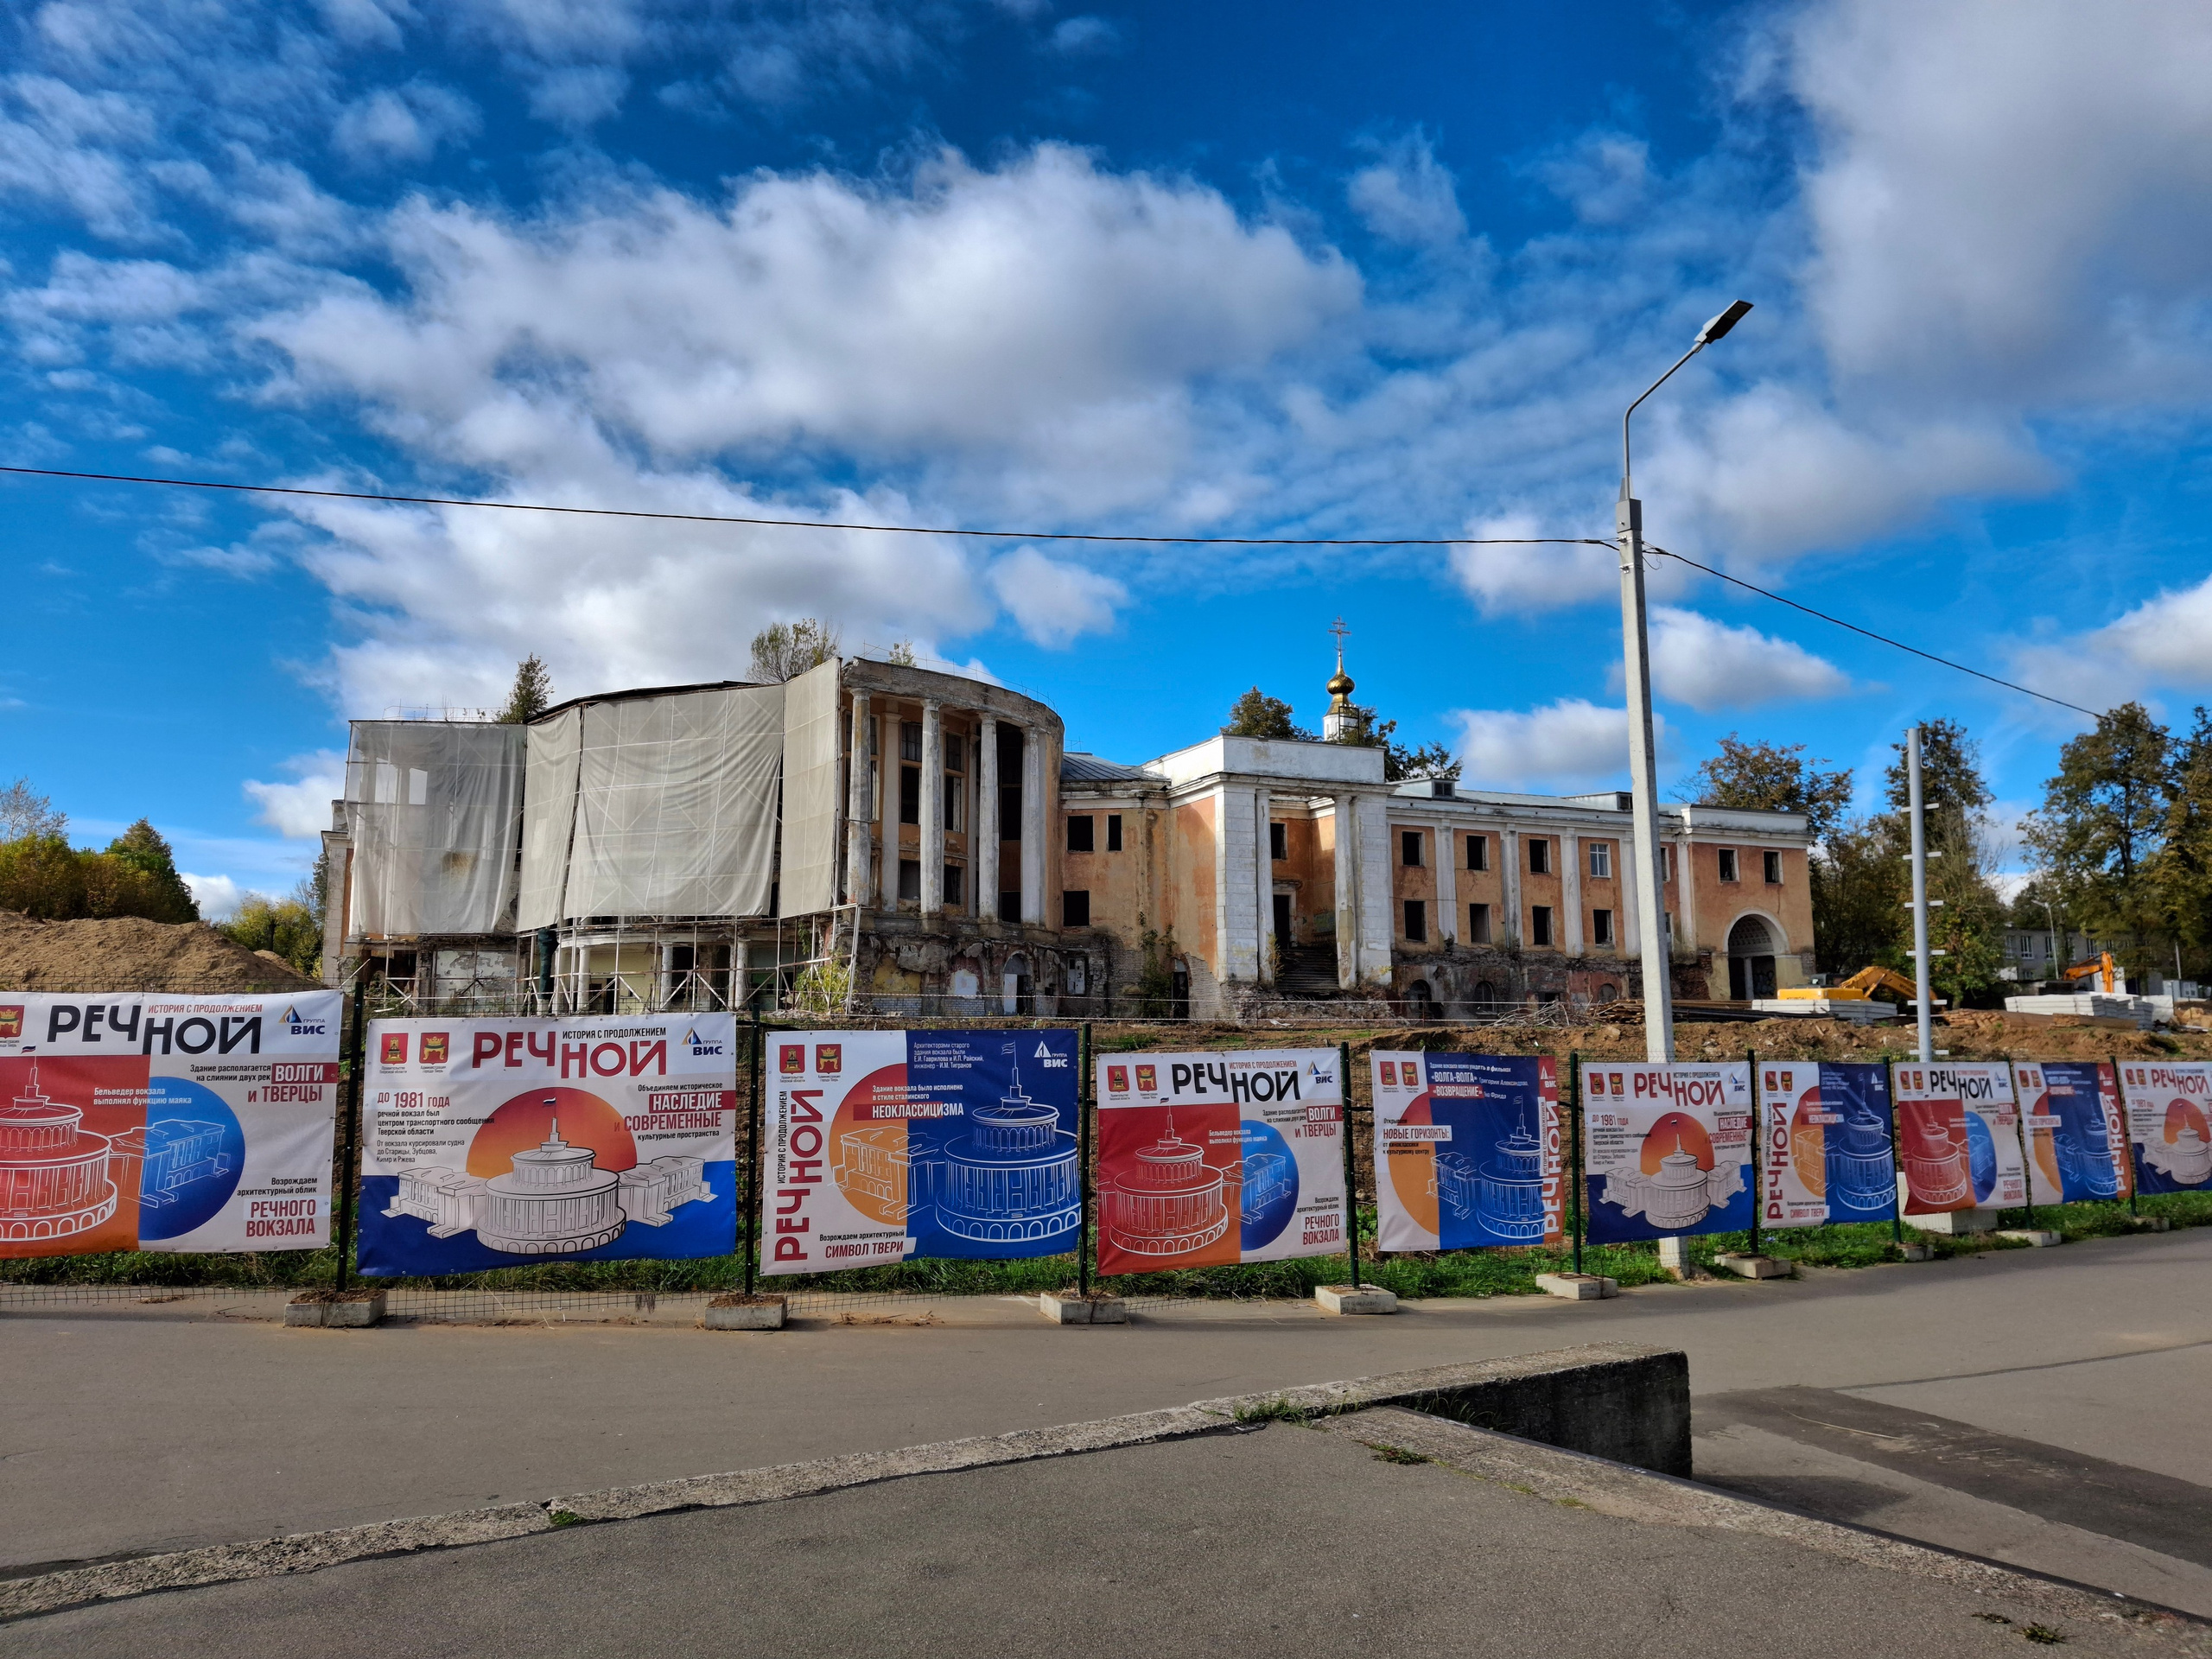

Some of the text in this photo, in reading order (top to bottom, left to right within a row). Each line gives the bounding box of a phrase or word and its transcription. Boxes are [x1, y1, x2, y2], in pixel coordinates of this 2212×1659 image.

[148, 1003, 263, 1014] ИСТОРИЯ С ПРОДОЛЖЕНИЕМ
[47, 1005, 262, 1054] РЕЧНОЙ
[290, 1025, 326, 1035] ВИС
[562, 1027, 666, 1039] ИСТОРИЯ С ПРОДОЛЖЕНИЕМ
[472, 1032, 666, 1078] РЕЧНОЙ
[692, 1046, 723, 1056] ВИС
[189, 1064, 271, 1073] Здание располагается
[1043, 1058, 1068, 1068] ВИС
[1229, 1061, 1252, 1070] ИСТОРИЯ
[238, 1074, 256, 1083] двух
[257, 1073, 270, 1082] рек
[275, 1065, 324, 1082] ВОЛГИ
[1315, 1075, 1333, 1084] ВИС
[1172, 1063, 1301, 1103] РЕЧНОЙ
[1634, 1072, 1726, 1106] РЕЧНОЙ
[1929, 1071, 1993, 1099] РЕЧНОЙ
[2151, 1069, 2210, 1094] РЕЧНОЙ
[94, 1087, 166, 1096] Бельведер вокзала
[262, 1085, 322, 1103] ТВЕРЦЫ
[93, 1096, 131, 1105] выполнял
[132, 1096, 168, 1106] функцию
[393, 1091, 423, 1109] 1981
[428, 1096, 450, 1108] ГОДА
[652, 1092, 722, 1110] НАСЛЕДИЕ
[378, 1109, 399, 1118] речной
[872, 1103, 964, 1118] НЕОКЛАССИЦИЗМА
[1308, 1106, 1336, 1121] ВОЛГИ
[624, 1111, 722, 1131] СОВРЕМЕННЫЕ
[779, 1090, 788, 1147] ПРОДОЛЖЕНИЕМ
[1600, 1114, 1617, 1126] 1981
[637, 1130, 720, 1141] культурные пространства
[1302, 1123, 1337, 1137] ТВЕРЦЫ
[1383, 1128, 1449, 1139] НОВЫЕ ГОРИЗОНТЫ:
[1767, 1103, 1789, 1219] РЕЧНОЙ
[774, 1090, 823, 1262] РЕЧНОЙ
[778, 1154, 786, 1184] ИСТОРИЯ
[271, 1177, 318, 1186] Возрождаем
[237, 1186, 294, 1197] архитектурный
[251, 1199, 316, 1218] РЕЧНОГО
[245, 1217, 315, 1237] ВОКЗАЛА
[1305, 1213, 1339, 1230] РЕЧНОГО
[819, 1230, 905, 1242] Возрождаем архитектурный
[1303, 1229, 1339, 1245] ВОКЗАЛА
[825, 1241, 904, 1258] СИМВОЛ ТВЕРИ
